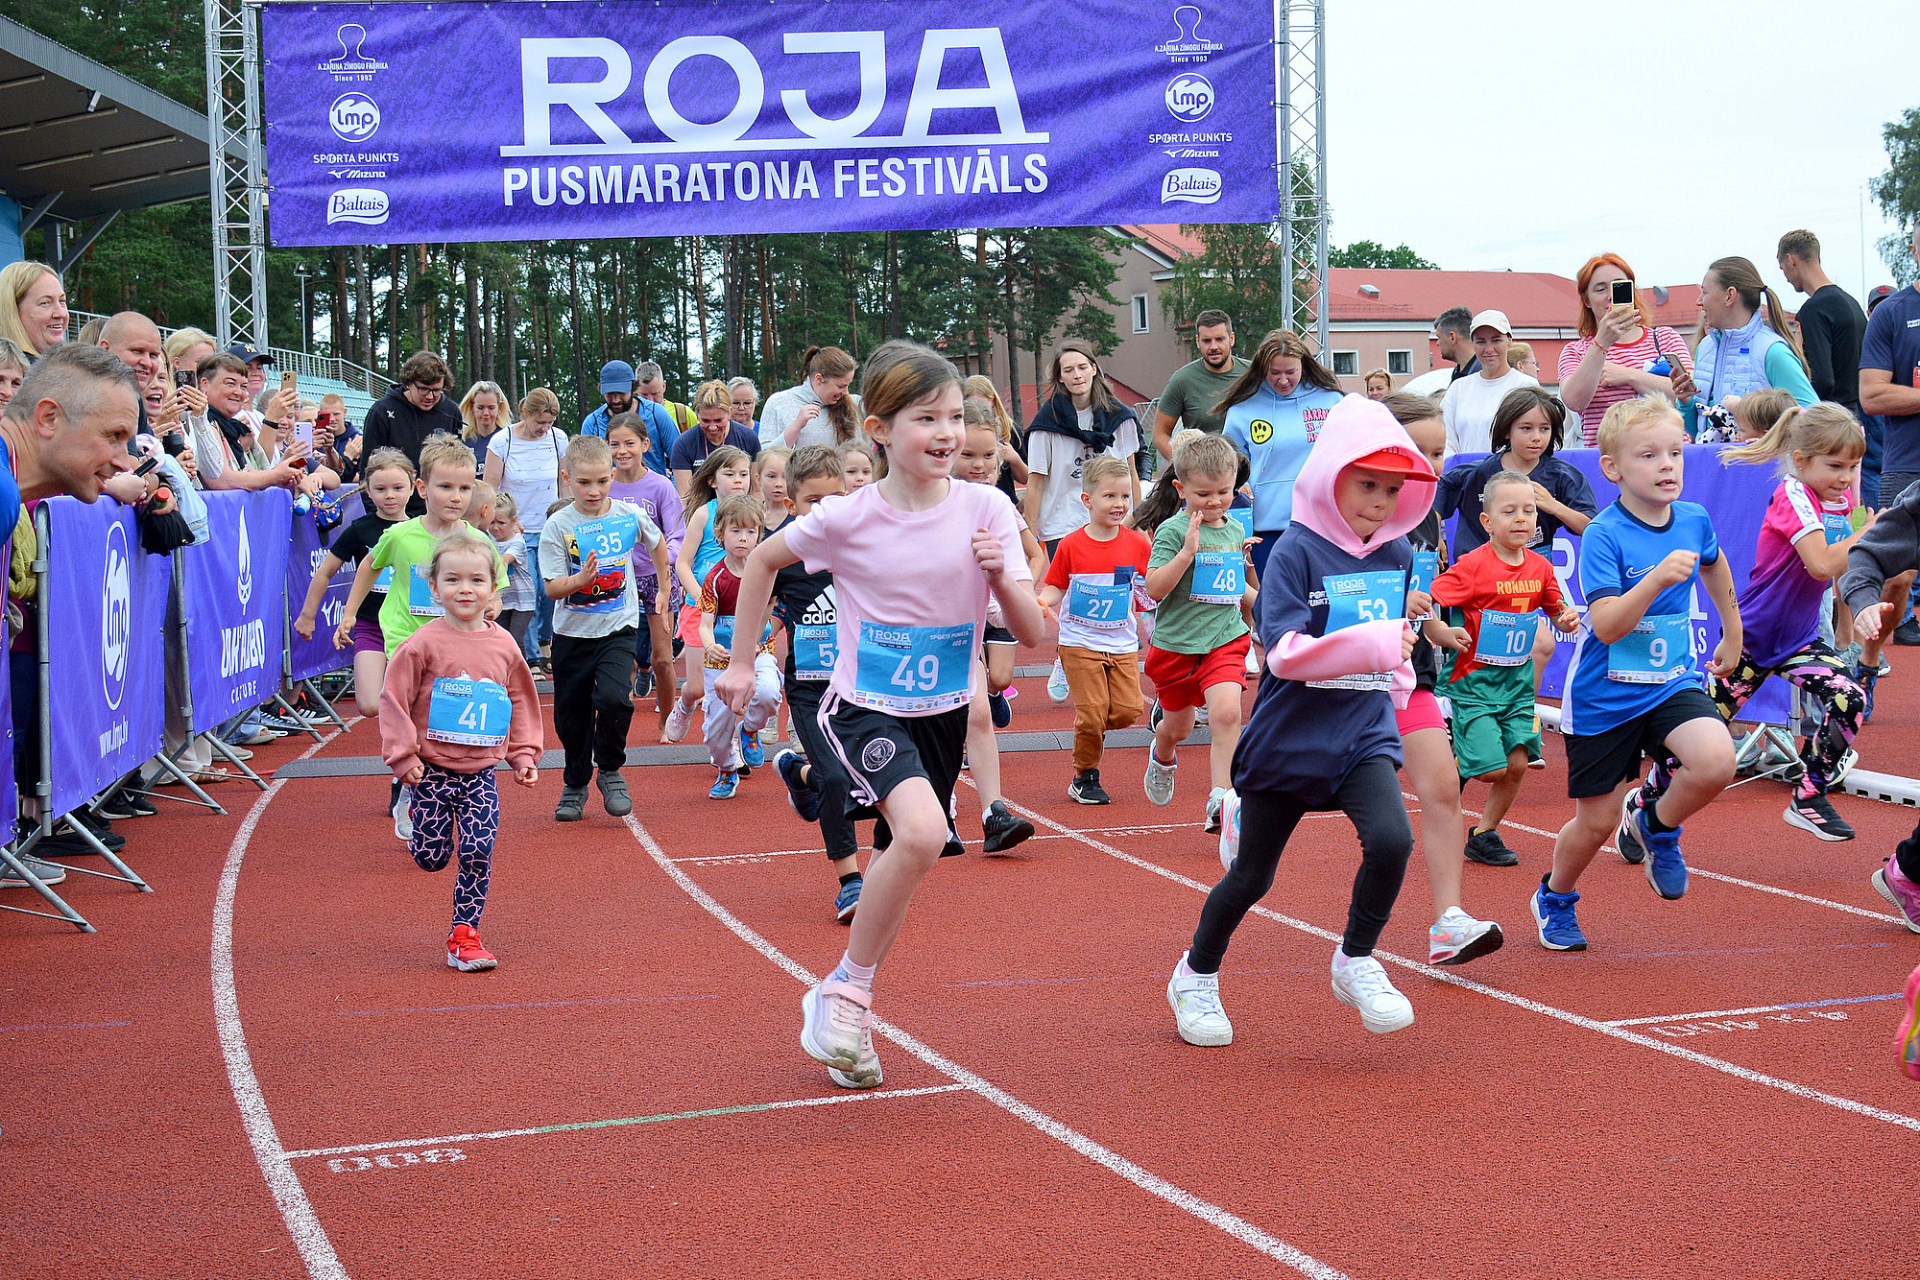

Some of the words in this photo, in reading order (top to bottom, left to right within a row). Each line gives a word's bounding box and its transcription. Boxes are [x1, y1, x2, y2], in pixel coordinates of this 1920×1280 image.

[1201, 43, 1223, 51] FABRIKA
[366, 62, 388, 70] FABRIKA
[519, 26, 1028, 147] ROJA
[1173, 90, 1208, 109] lmp
[337, 109, 374, 128] lmp
[1148, 133, 1190, 144] SPORTA
[1192, 132, 1233, 143] PUNKTS
[313, 153, 356, 164] SPORTA
[358, 152, 399, 163] PUNKTS
[503, 161, 820, 207] PUSMARATONA
[836, 147, 1048, 198] FESTIVĀLS
[1167, 175, 1217, 193] Baltais
[333, 195, 384, 214] Baltais
[595, 532, 622, 555] 35
[1212, 568, 1236, 591] 48
[1337, 579, 1366, 589] ROJA
[1496, 579, 1542, 594] RONALDO
[1087, 599, 1114, 619] 27
[1357, 598, 1388, 621] 53
[1511, 597, 1531, 614] 7
[802, 608, 837, 624] adid
[1493, 614, 1516, 622] ROJA
[875, 630, 911, 640] ROJA
[1506, 630, 1527, 654] 10
[1649, 638, 1668, 667] 9
[891, 654, 939, 691] 49
[445, 683, 472, 692] ROJA
[458, 702, 487, 730] 41
